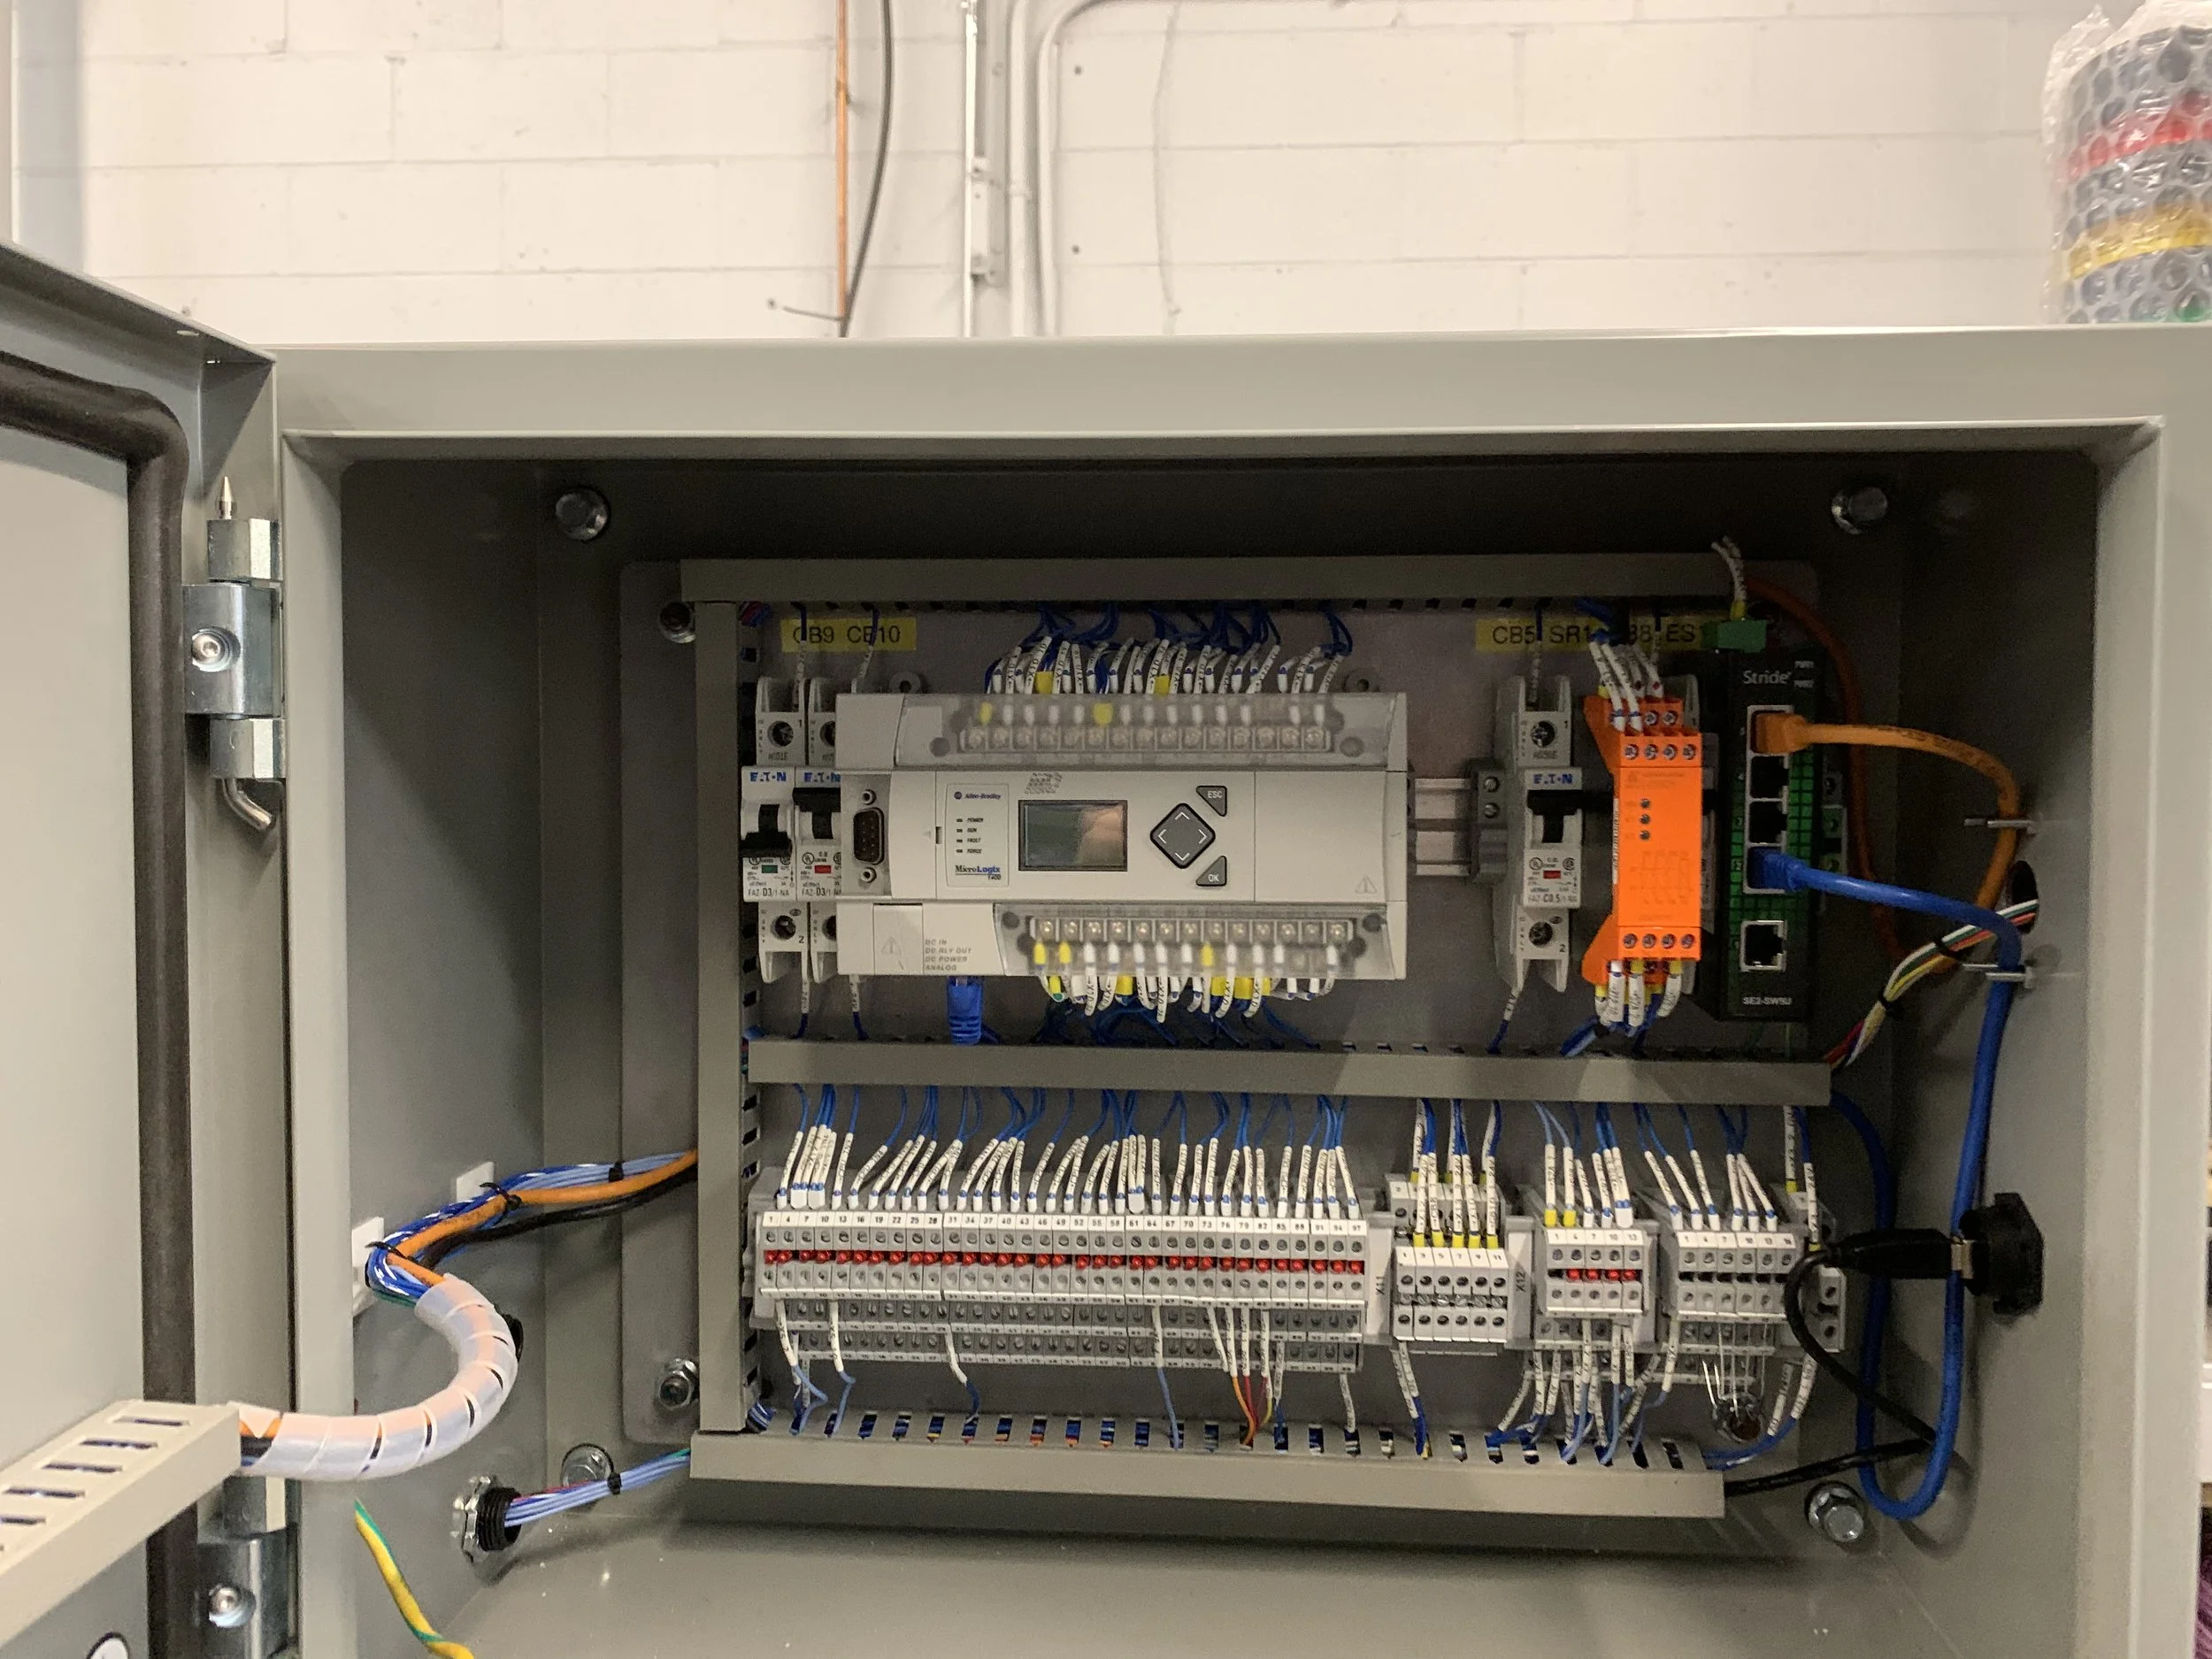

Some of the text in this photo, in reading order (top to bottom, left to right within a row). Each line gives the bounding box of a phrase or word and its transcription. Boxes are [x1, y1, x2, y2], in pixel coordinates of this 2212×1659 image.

[1743, 669, 1787, 685] Stride
[1207, 790, 1223, 799] ESC
[1208, 873, 1219, 882] OK
[1559, 944, 1566, 953] 2
[1056, 1217, 1066, 1226] 49
[1202, 1220, 1212, 1229] 73
[1515, 1271, 1526, 1293] X12
